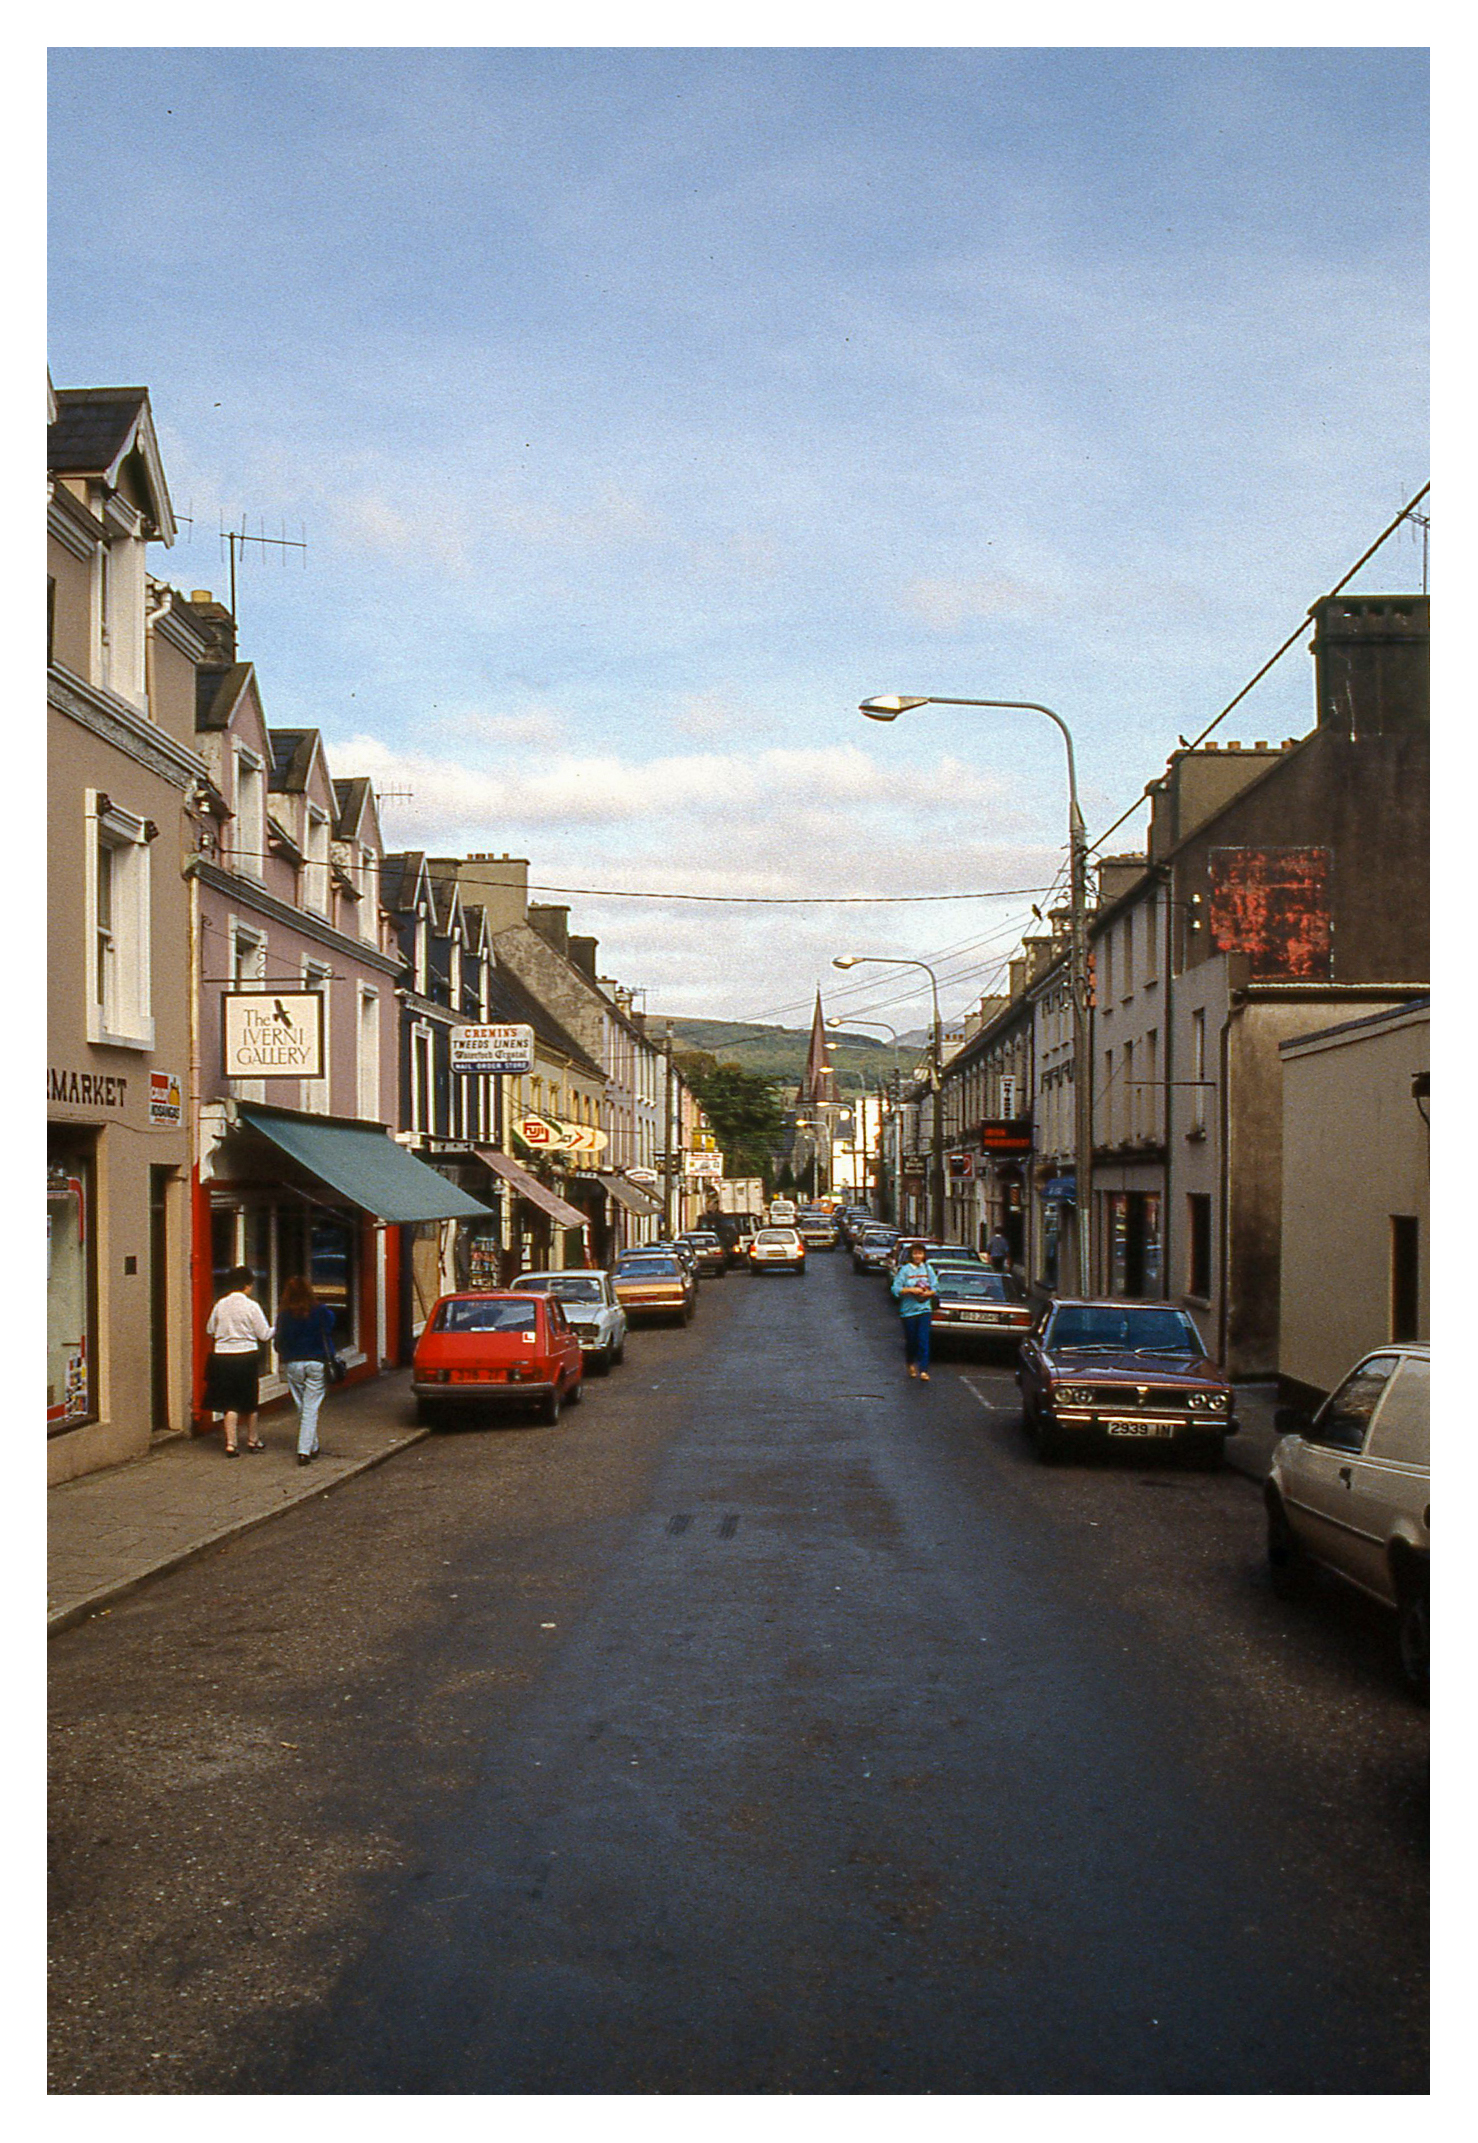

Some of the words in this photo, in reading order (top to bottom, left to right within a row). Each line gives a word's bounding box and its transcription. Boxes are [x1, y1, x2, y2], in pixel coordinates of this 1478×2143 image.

[243, 1009, 271, 1027] The
[243, 1028, 304, 1046] IVERNI
[452, 1040, 489, 1049] TWEEDS
[494, 1039, 529, 1048] LINENS
[236, 1047, 312, 1065] GALLERY
[1110, 1423, 1148, 1434] 2939
